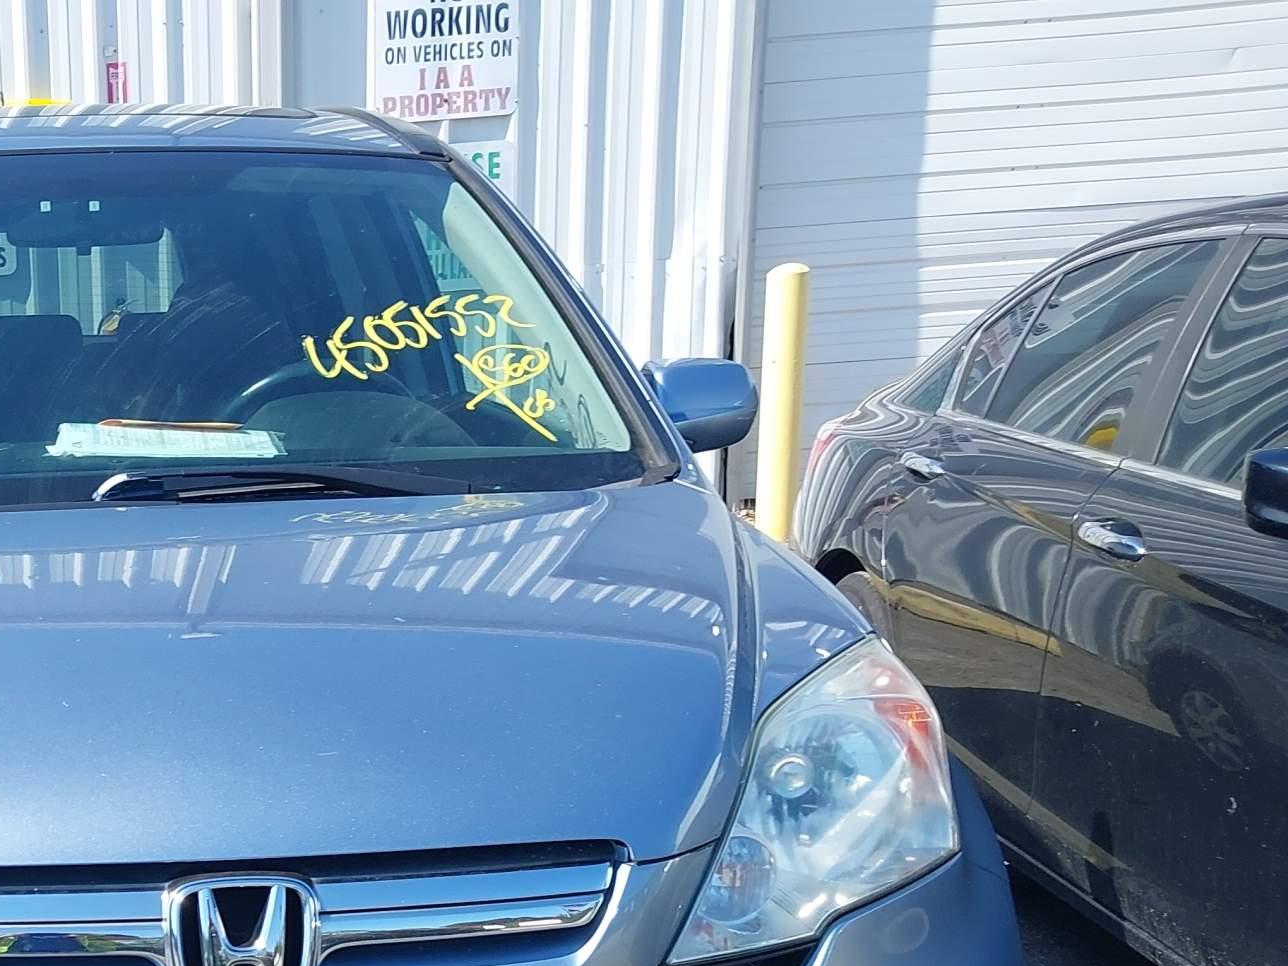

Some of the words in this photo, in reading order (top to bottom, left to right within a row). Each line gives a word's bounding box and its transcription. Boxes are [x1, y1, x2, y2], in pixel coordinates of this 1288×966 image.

[386, 3, 510, 40] WORKING
[385, 46, 407, 65] ON
[413, 43, 484, 63] VEHICLES
[491, 39, 512, 58] ON
[383, 87, 511, 118] PROPERTY
